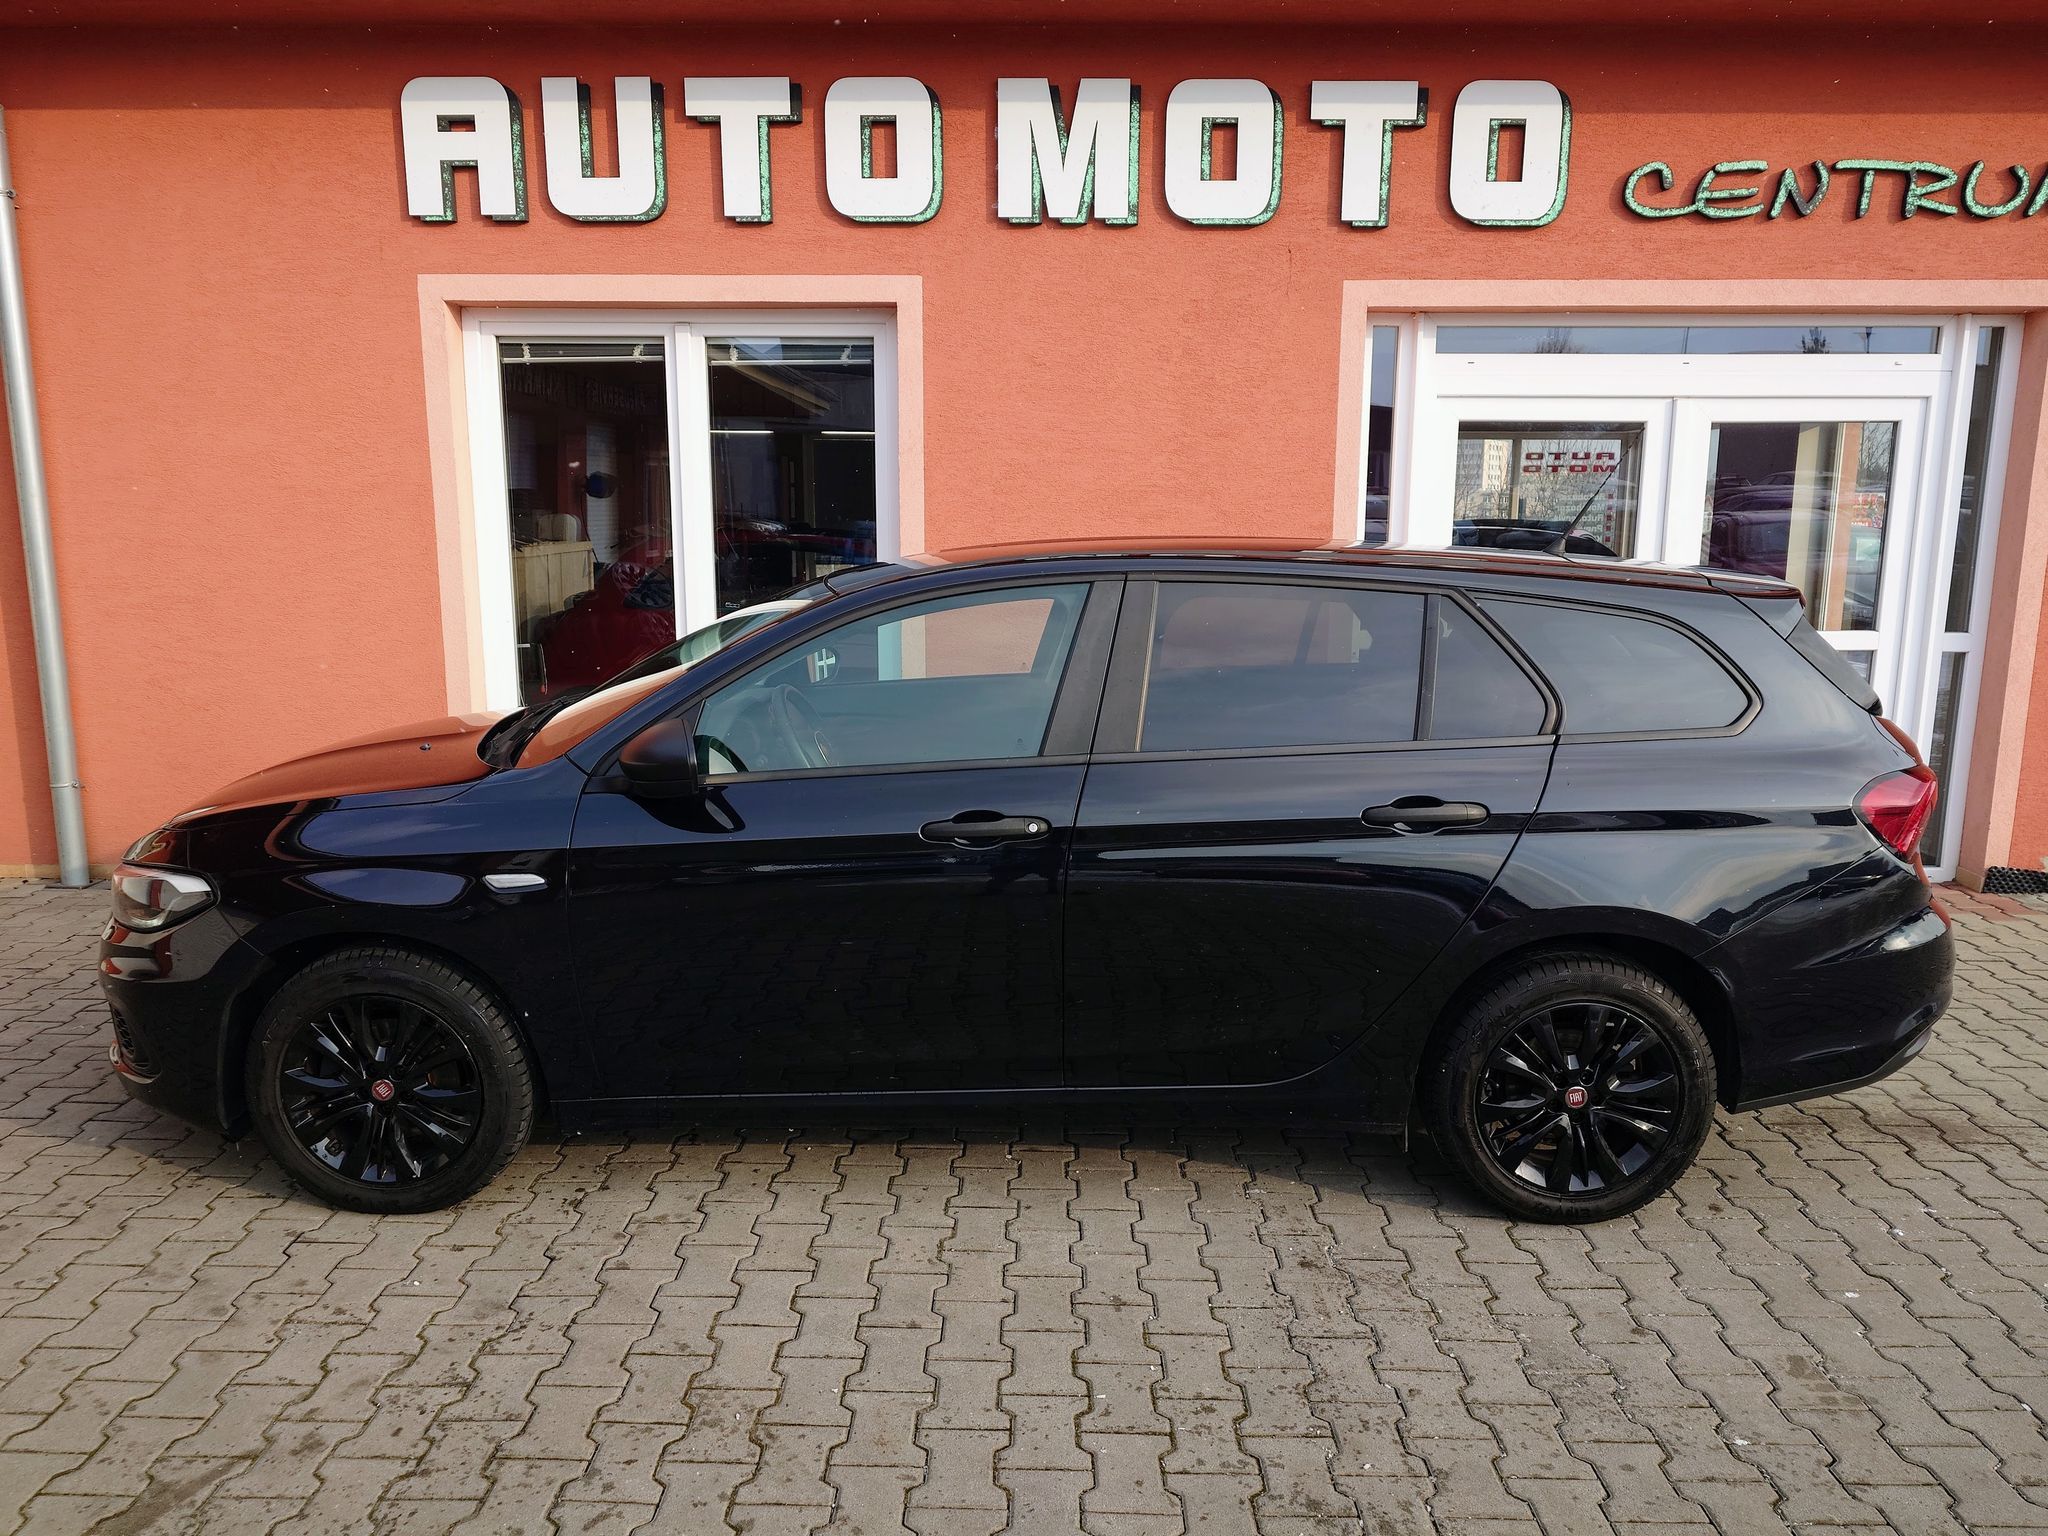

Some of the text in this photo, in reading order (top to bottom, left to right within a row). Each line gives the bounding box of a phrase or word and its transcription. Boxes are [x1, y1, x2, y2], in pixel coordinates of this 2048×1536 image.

[401, 76, 2048, 226] AUTO MOTO CENTRU
[375, 1083, 391, 1097] FIAT
[1569, 1091, 1583, 1104] FIAT
